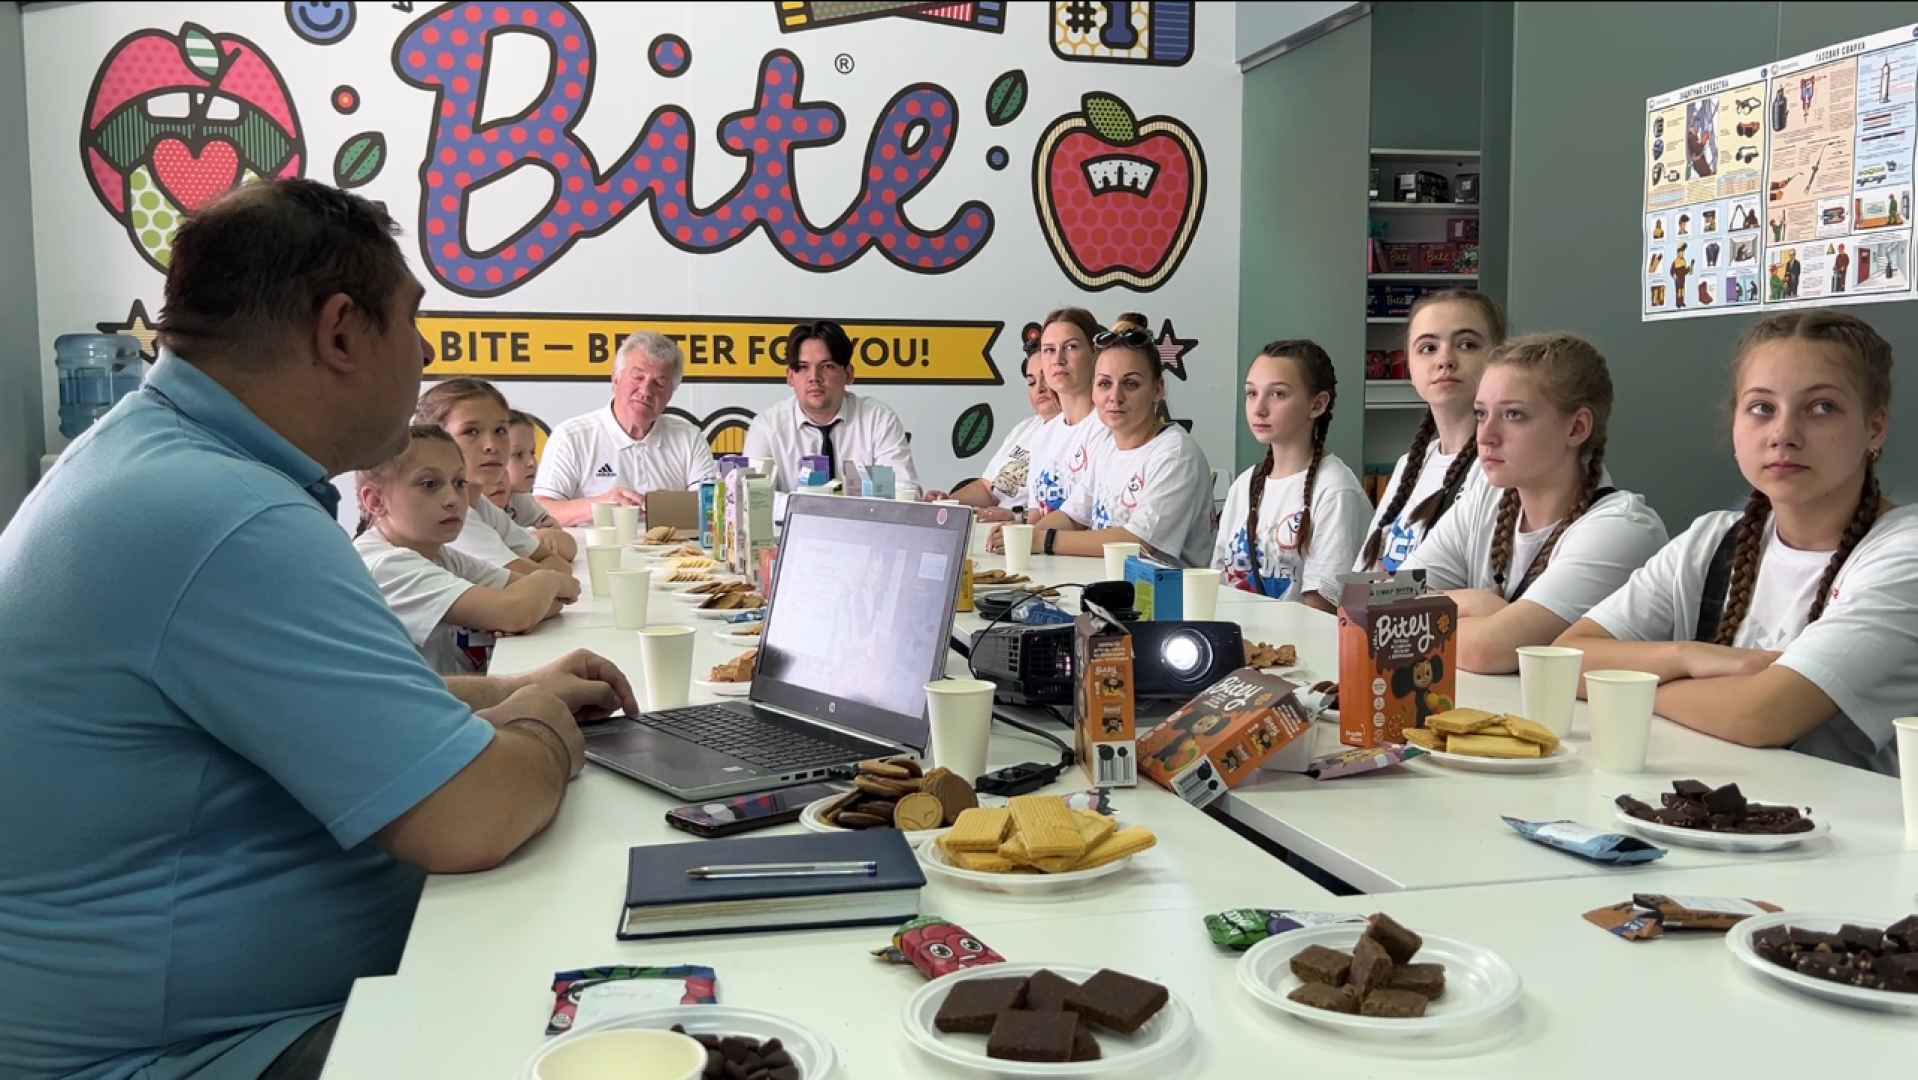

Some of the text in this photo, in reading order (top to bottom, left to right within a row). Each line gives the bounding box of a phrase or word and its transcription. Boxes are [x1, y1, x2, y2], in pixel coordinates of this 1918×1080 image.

[391, 2, 995, 298] Bite
[440, 331, 530, 362] BITE
[748, 335, 791, 365] FO
[1375, 612, 1435, 654] Bitey
